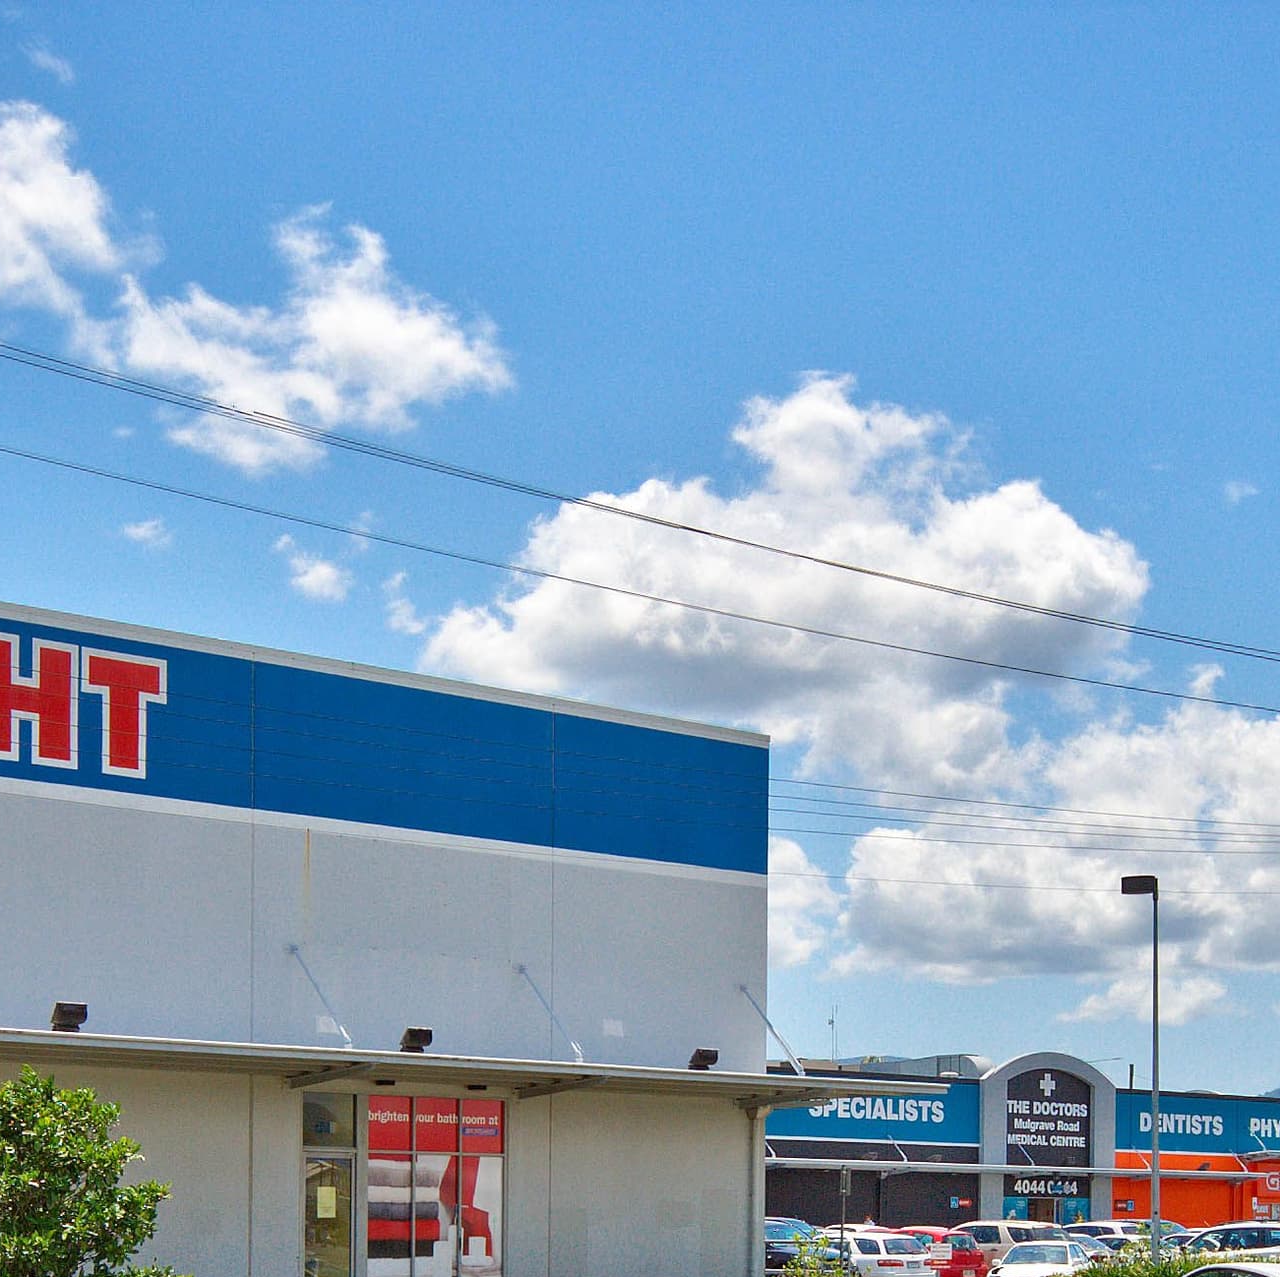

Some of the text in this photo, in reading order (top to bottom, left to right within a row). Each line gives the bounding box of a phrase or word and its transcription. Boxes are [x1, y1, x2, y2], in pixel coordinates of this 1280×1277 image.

[808, 1097, 945, 1123] SPECIALISTS
[1007, 1100, 1088, 1117] THE DOCTORS
[368, 1110, 409, 1124] brighten
[1014, 1118, 1080, 1132] Mulgrave Road
[1007, 1134, 1086, 1148] MEDICAL CENTRE
[1014, 1180, 1046, 1194] 4044
